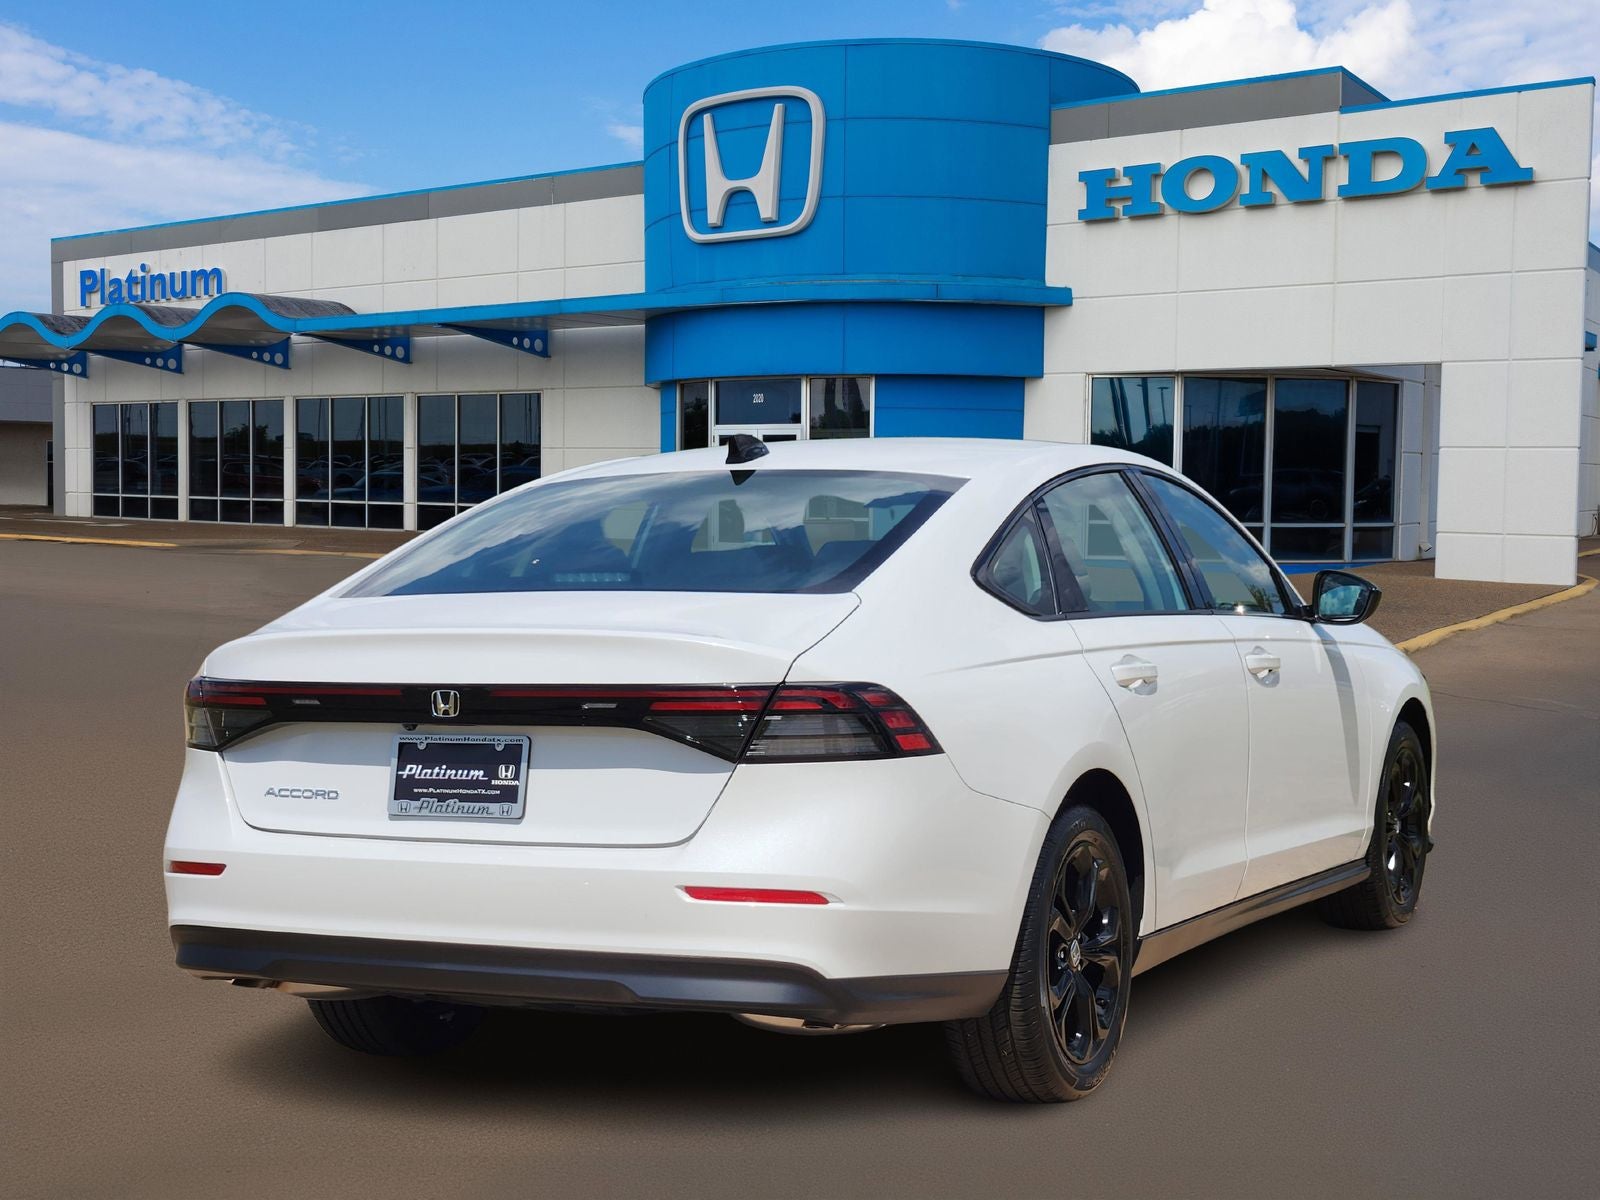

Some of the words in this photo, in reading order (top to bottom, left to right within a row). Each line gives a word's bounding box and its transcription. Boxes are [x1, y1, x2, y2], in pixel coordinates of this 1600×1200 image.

[1078, 127, 1534, 221] HONDA
[79, 263, 226, 308] Platinum
[398, 764, 489, 780] Platinum
[264, 787, 340, 800] ACCORD
[413, 799, 495, 815] Platinum
